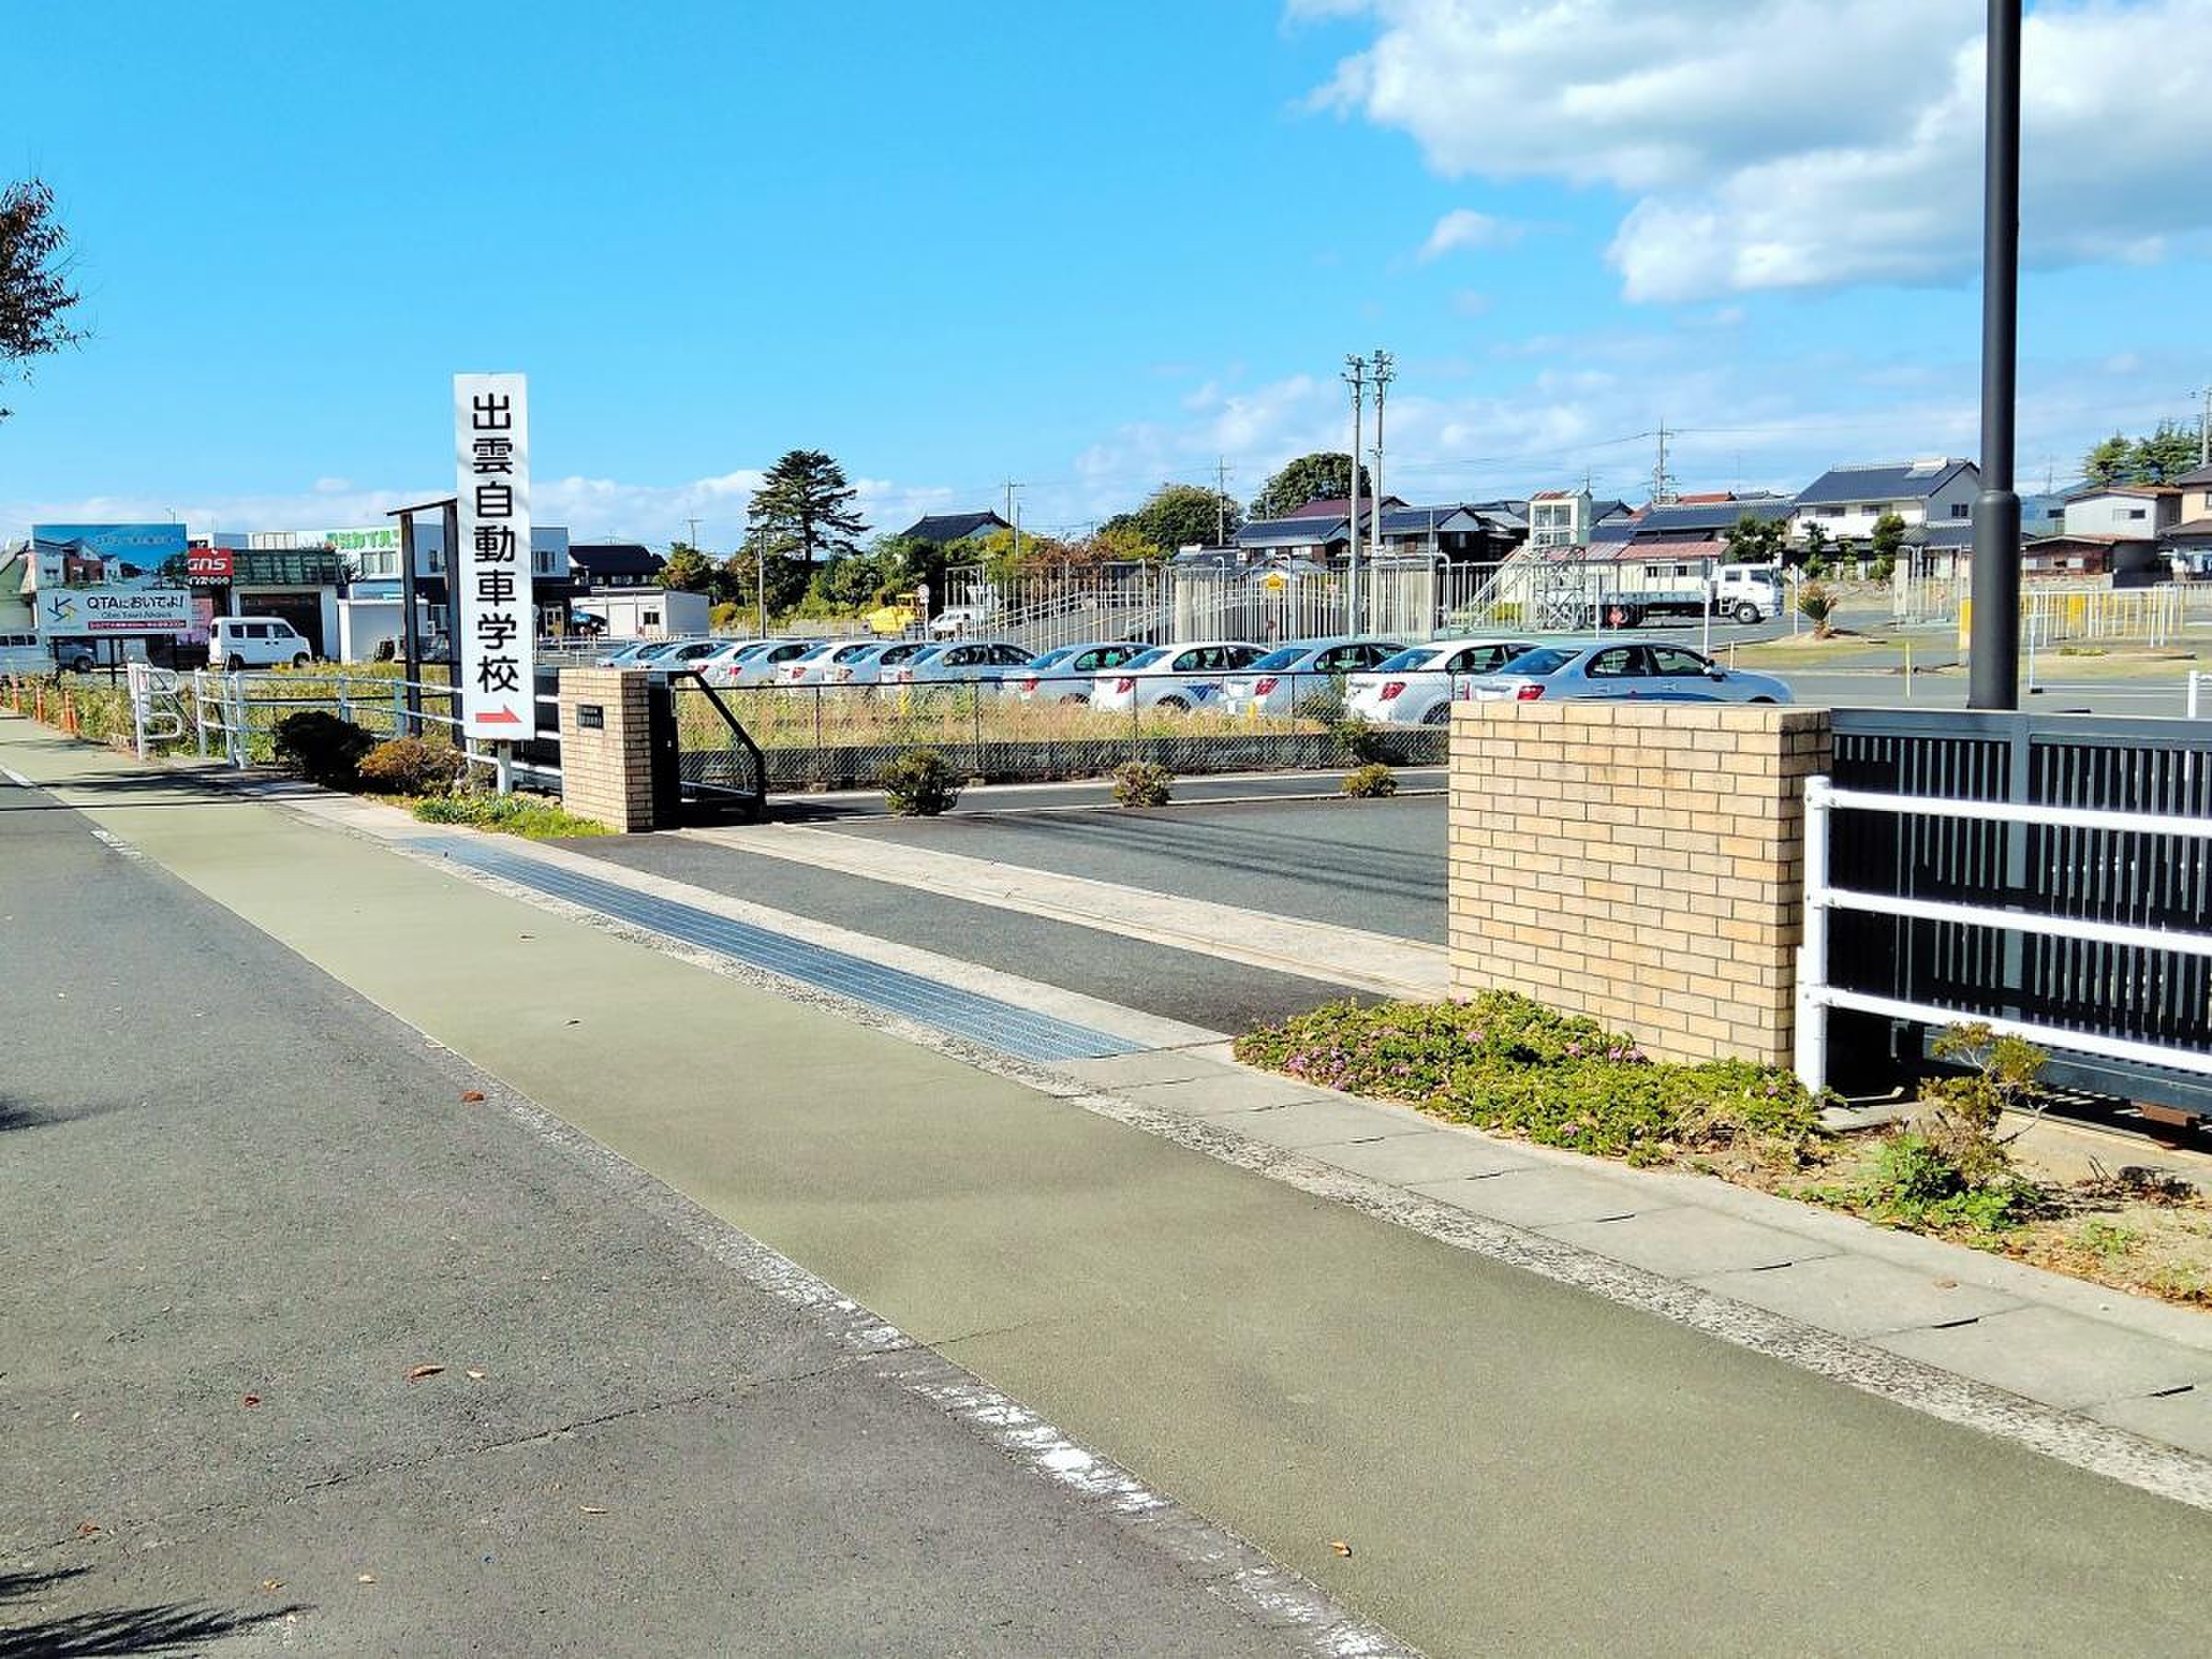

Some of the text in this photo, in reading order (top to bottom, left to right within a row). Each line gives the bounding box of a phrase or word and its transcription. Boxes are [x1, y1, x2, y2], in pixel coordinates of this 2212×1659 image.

[473, 393, 519, 693] 出雲自動車学校
